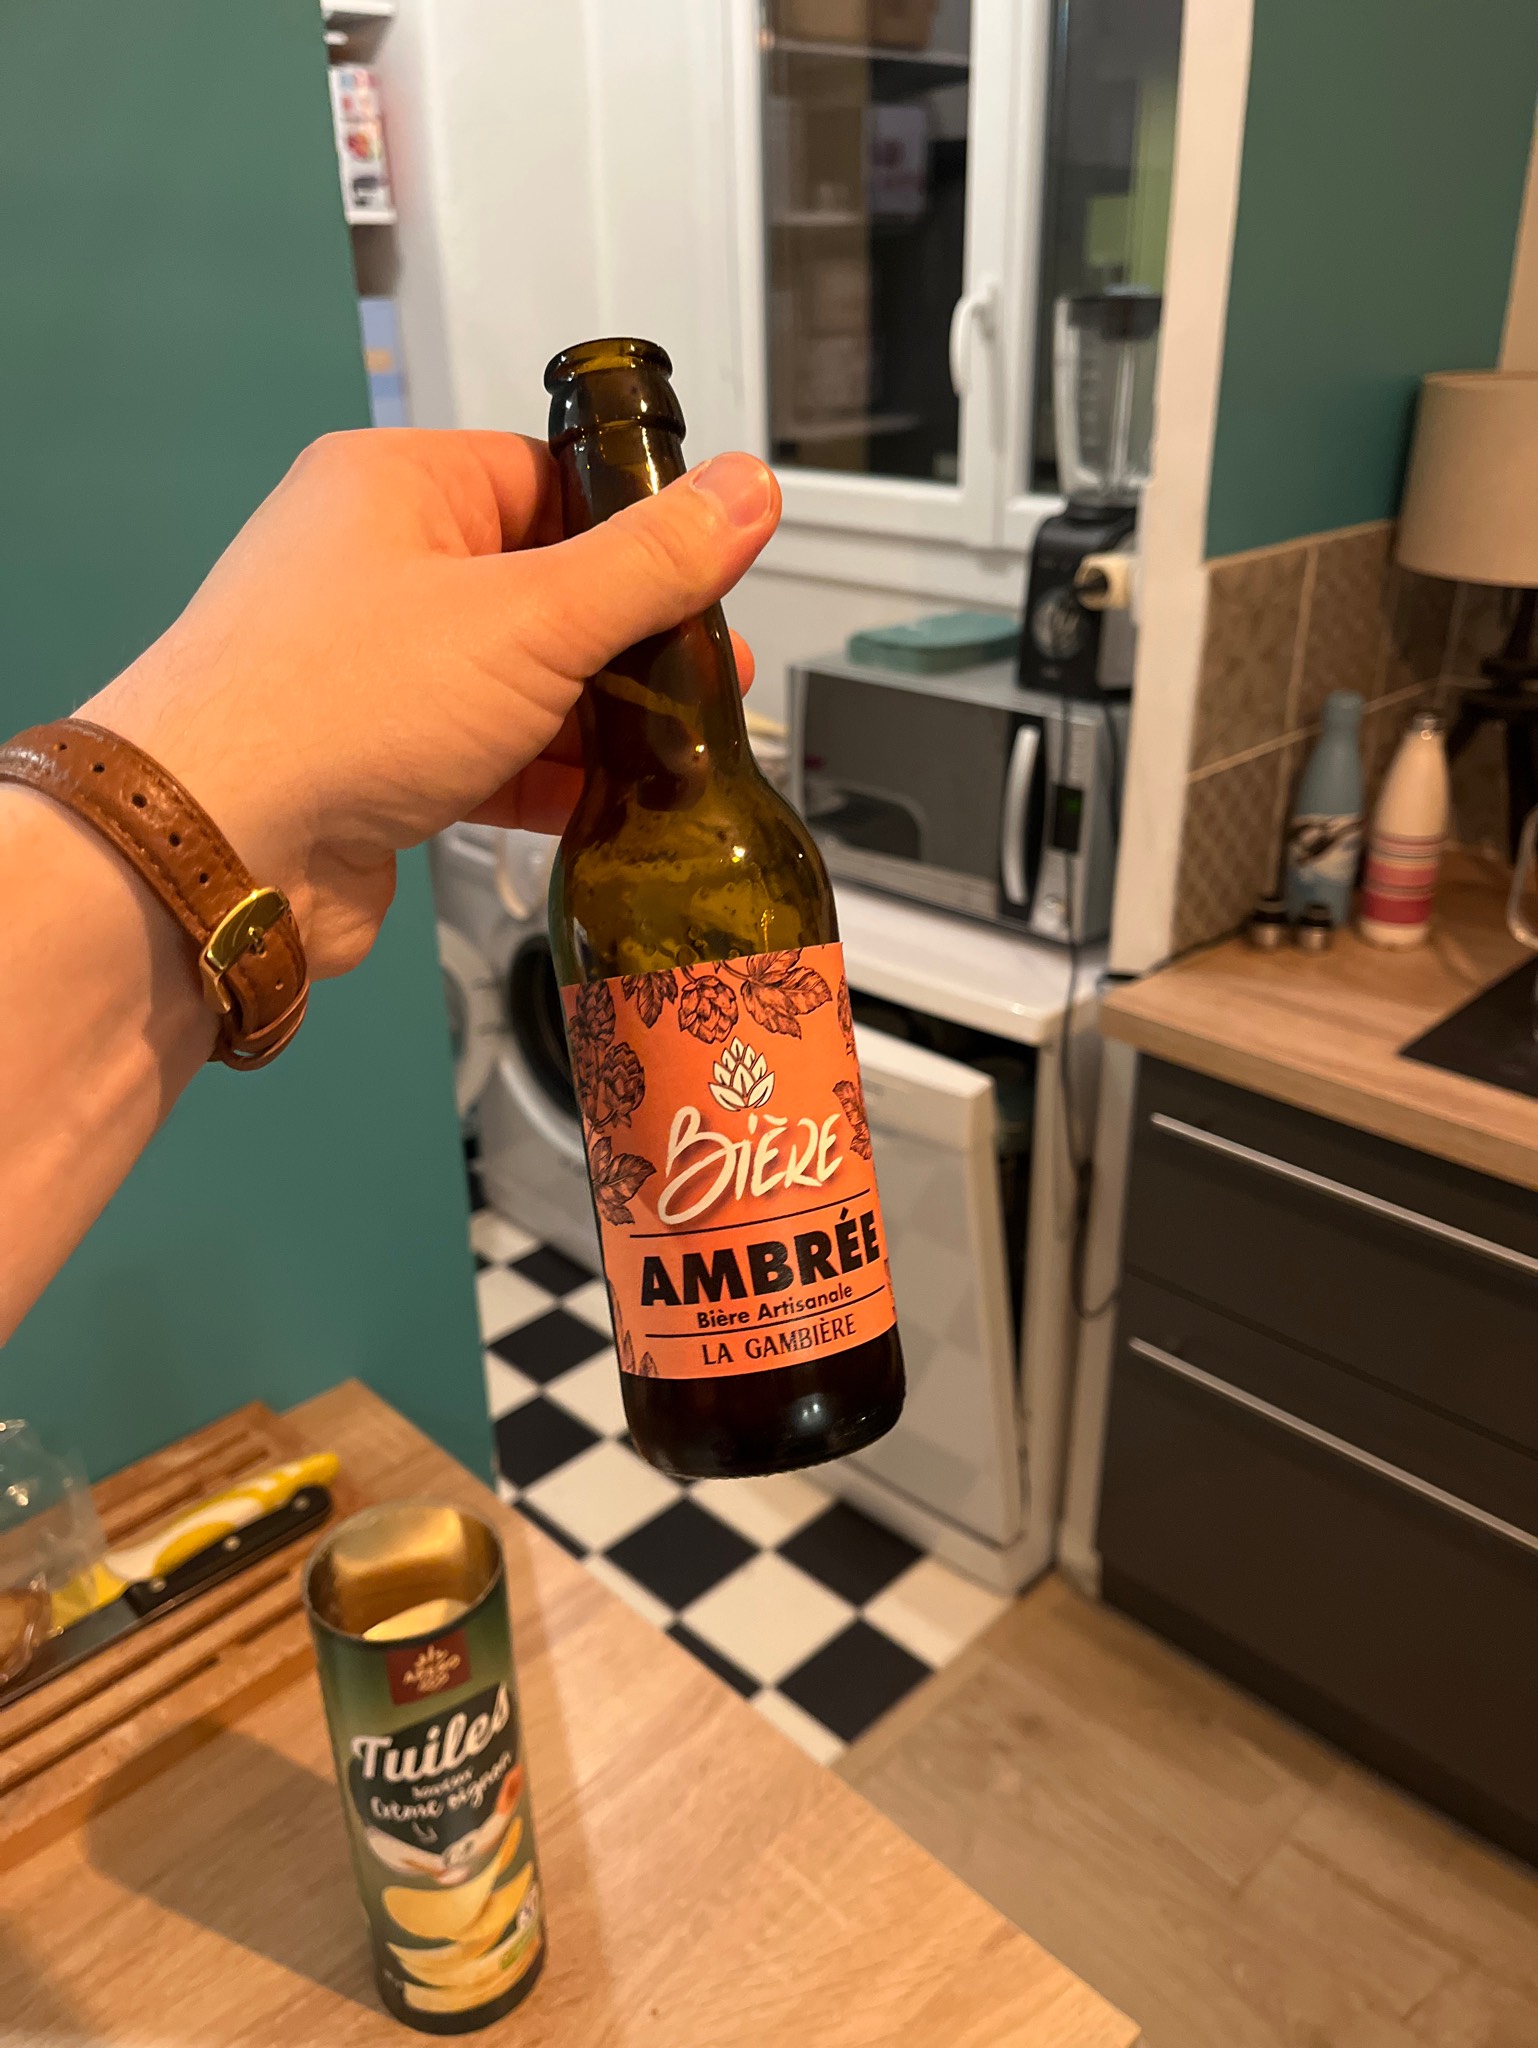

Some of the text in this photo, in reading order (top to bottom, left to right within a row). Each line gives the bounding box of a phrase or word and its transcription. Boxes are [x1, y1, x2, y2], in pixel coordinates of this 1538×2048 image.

[641, 1208, 880, 1307] AMBRÉE
[697, 1283, 853, 1329] Bière Artisanale
[703, 1313, 857, 1366] LA GAMBIÈRE
[351, 1682, 510, 1783] Tuiles
